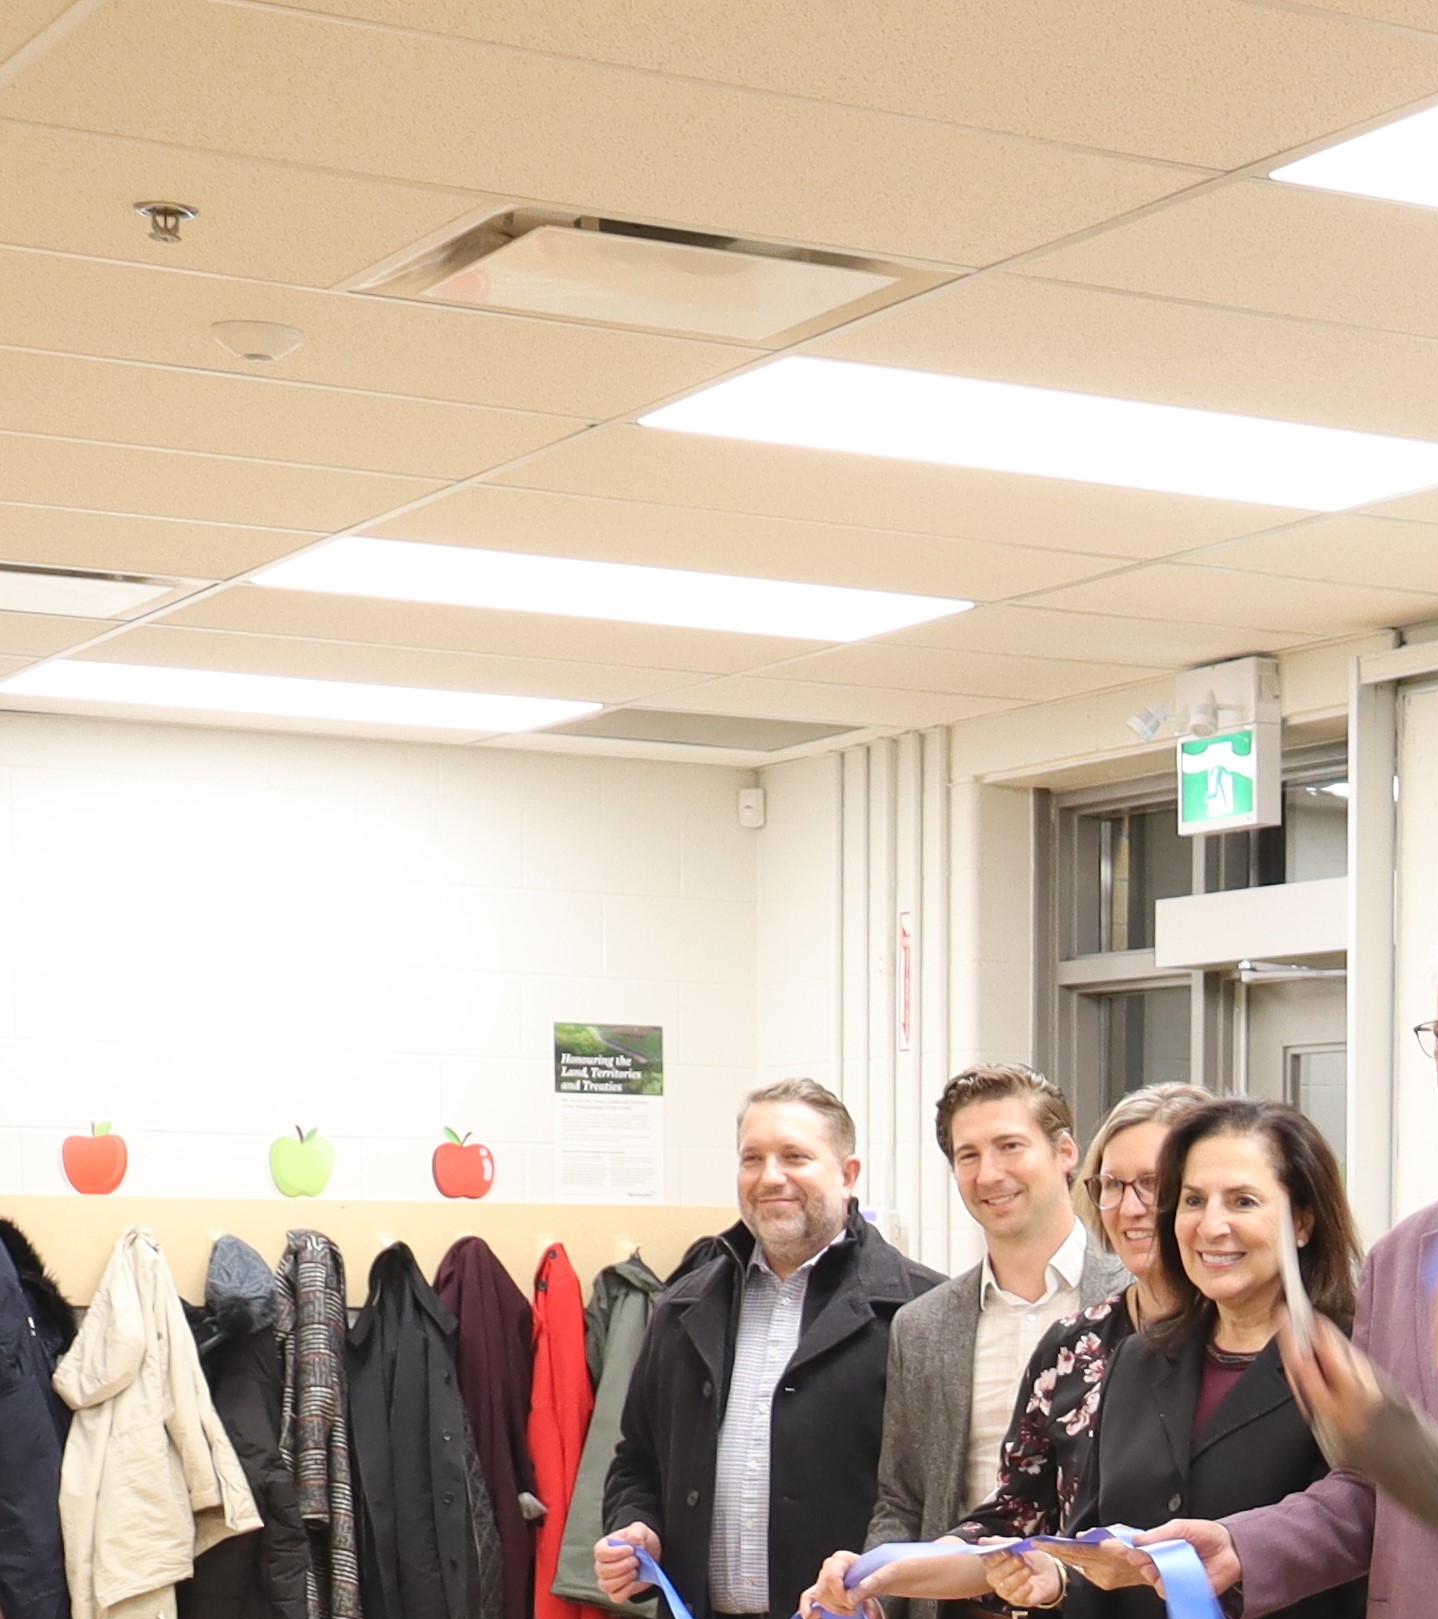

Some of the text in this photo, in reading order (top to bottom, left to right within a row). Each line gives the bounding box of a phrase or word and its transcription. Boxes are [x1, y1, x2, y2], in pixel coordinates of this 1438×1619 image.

[561, 1053, 633, 1069] Honouring the
[590, 1066, 643, 1079] Territories
[561, 1079, 623, 1092] and Treaties
